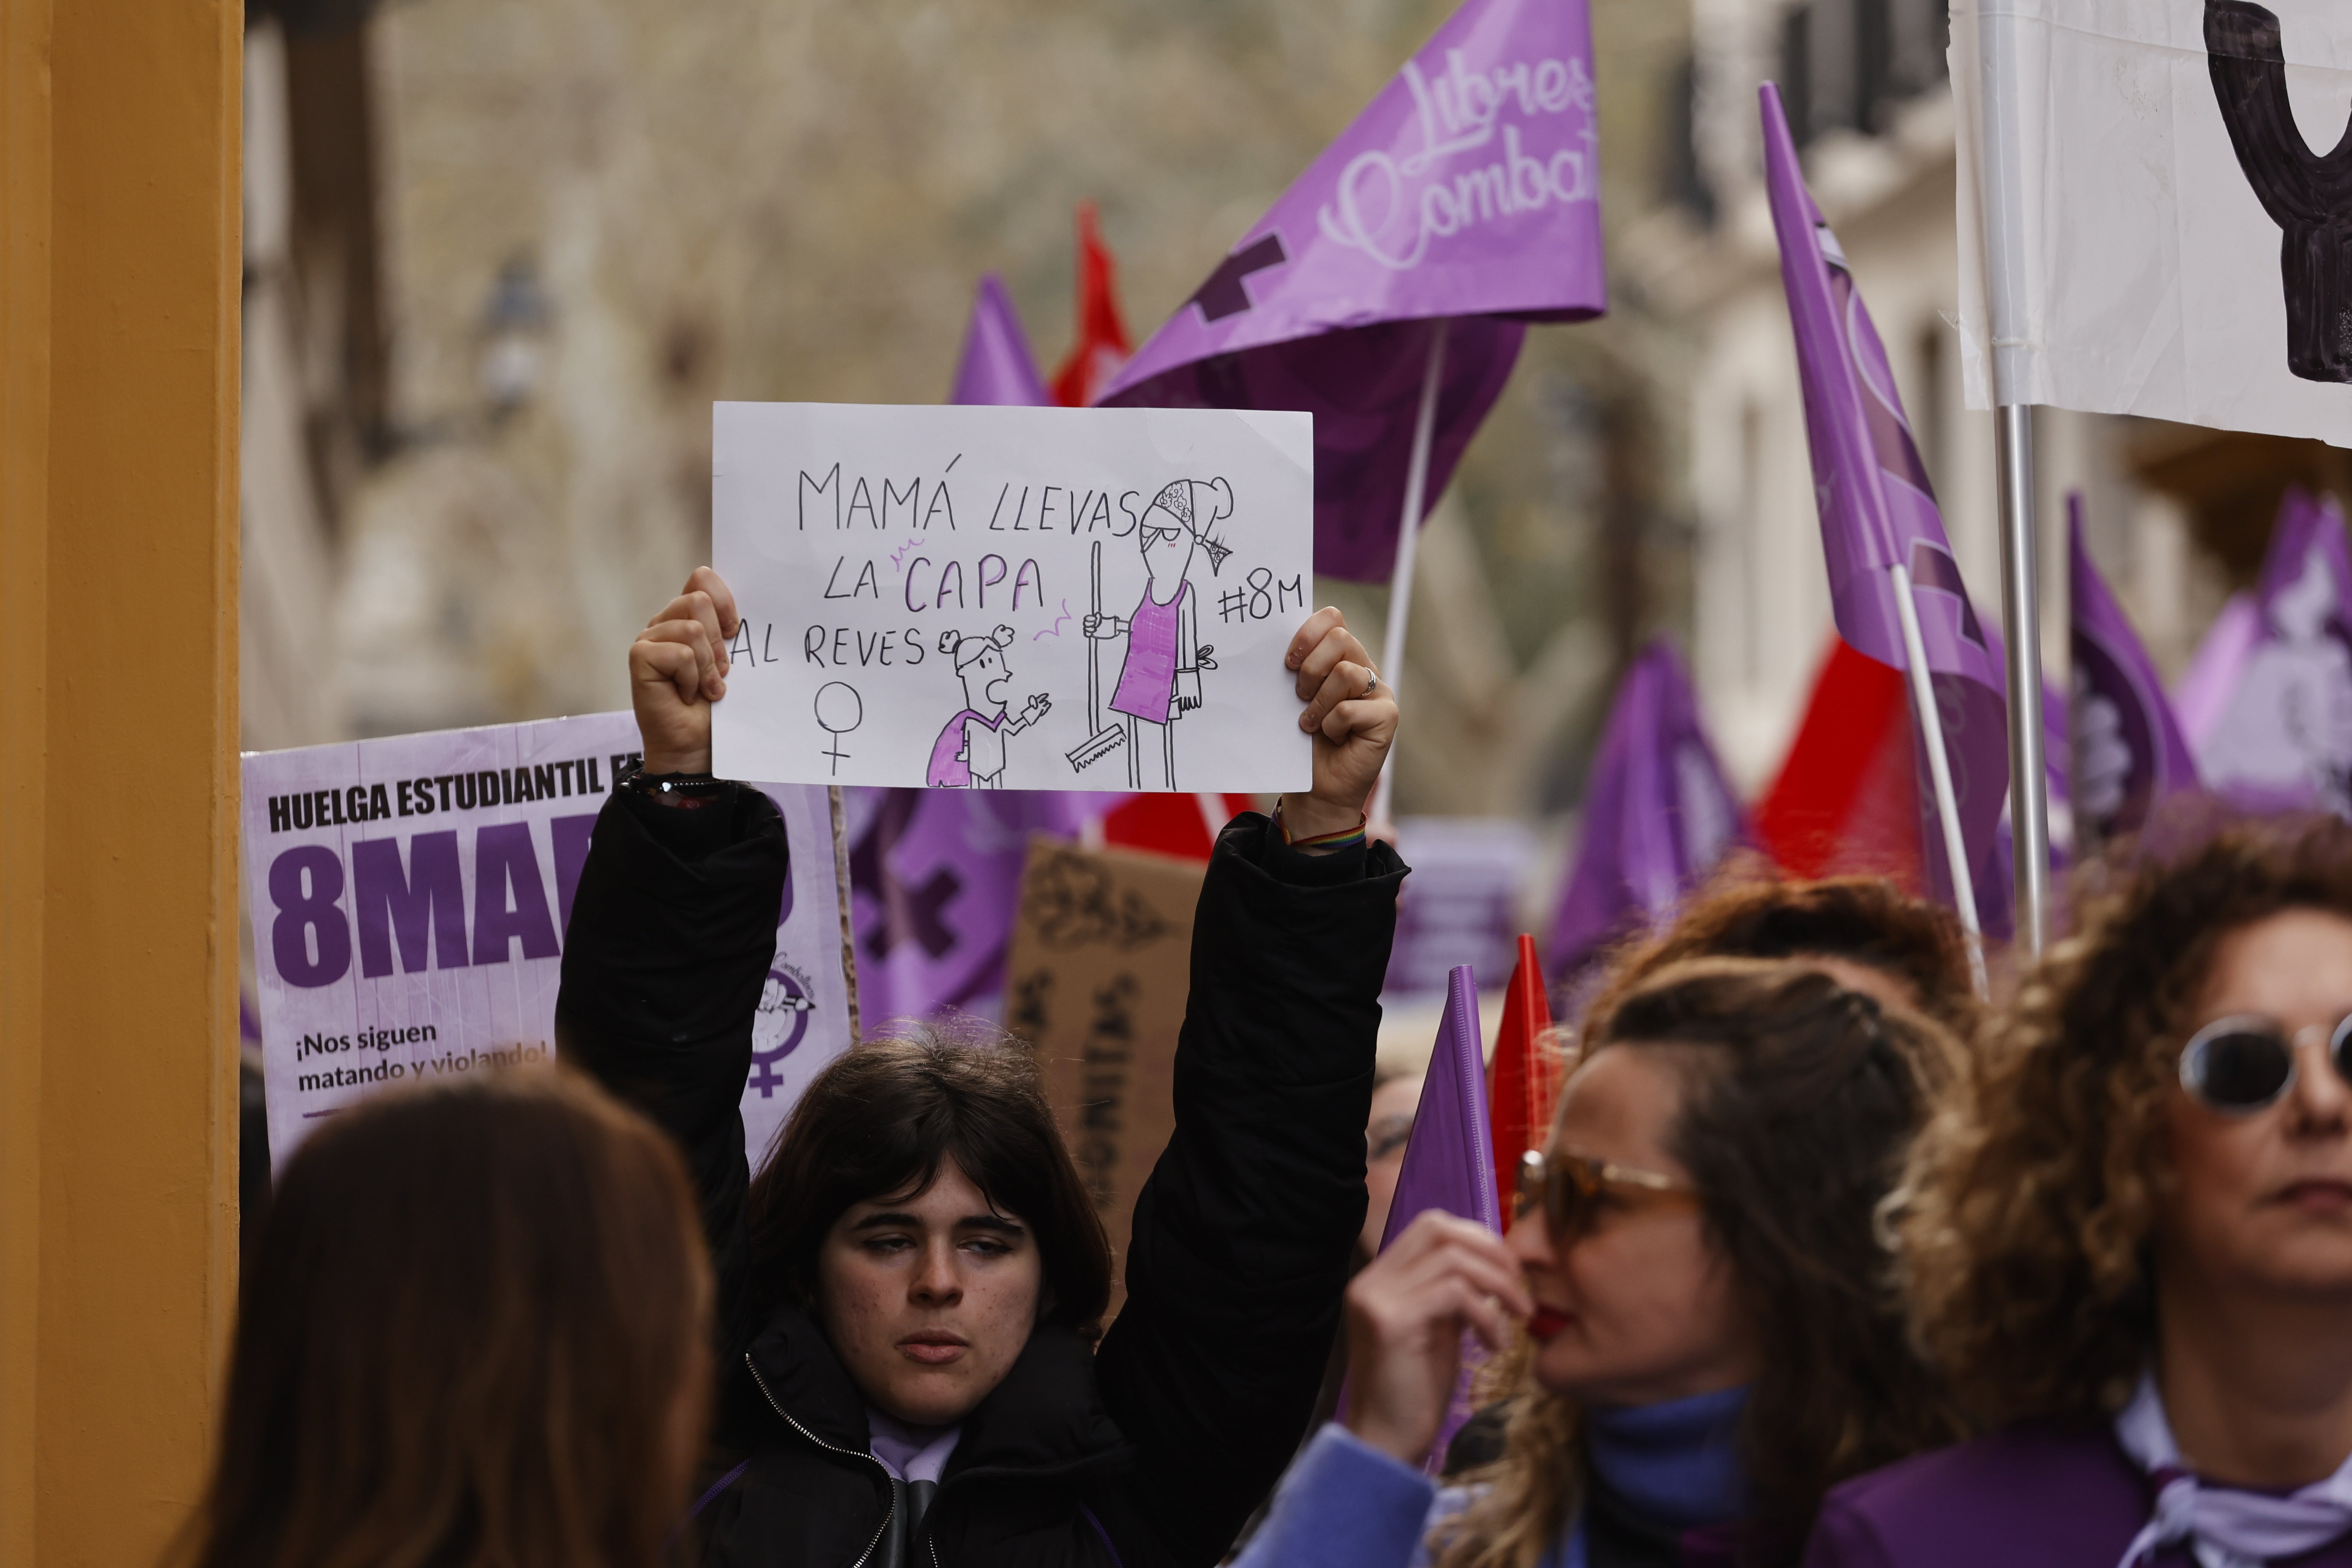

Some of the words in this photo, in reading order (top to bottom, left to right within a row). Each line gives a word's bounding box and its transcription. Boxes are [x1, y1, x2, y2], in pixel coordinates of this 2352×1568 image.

[799, 454, 962, 530] MAMÁ
[989, 482, 1140, 537] LLEVAS
[824, 556, 879, 599] LA
[904, 554, 1043, 612] CAPA
[1218, 567, 1303, 623] #8M
[729, 618, 778, 667] AL
[804, 623, 925, 667] REVES
[268, 783, 391, 833] HUELGA
[396, 757, 604, 817] ESTUDIANTIL
[296, 1033, 350, 1061] ¡Nos
[357, 1024, 437, 1050] siguen
[298, 1059, 405, 1091] matando
[430, 1039, 547, 1075] violando!
